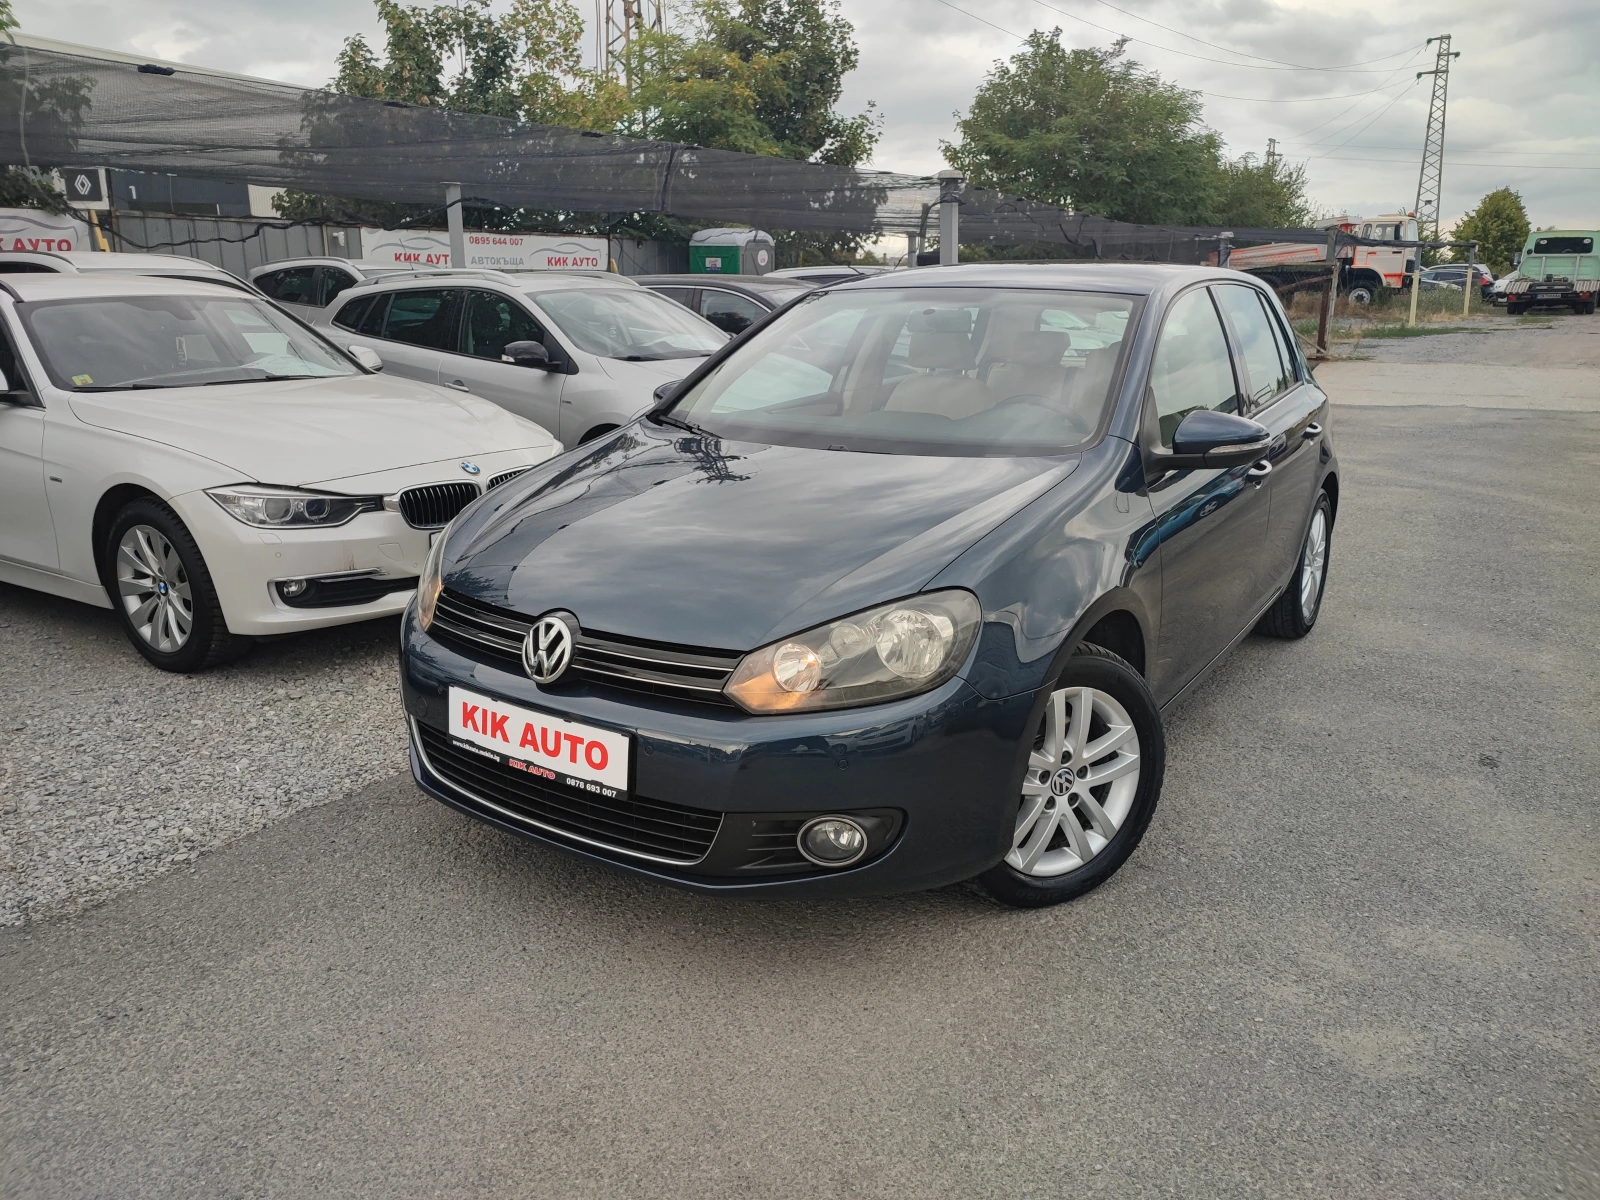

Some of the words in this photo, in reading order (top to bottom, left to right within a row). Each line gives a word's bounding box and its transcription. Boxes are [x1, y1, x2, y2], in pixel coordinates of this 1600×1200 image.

[469, 236, 490, 244] 0895
[509, 238, 524, 246] 007
[426, 254, 450, 265] АУТ
[470, 257, 524, 266] АВТОКЪЩА
[547, 257, 568, 266] КИК
[572, 257, 598, 267] АУТО
[462, 701, 510, 743] KIK
[519, 722, 609, 771] AUTO
[509, 758, 527, 771] KIK
[528, 765, 555, 780] AUTO
[566, 777, 585, 789] 0878
[586, 783, 600, 793] 693
[602, 788, 617, 798] 007
